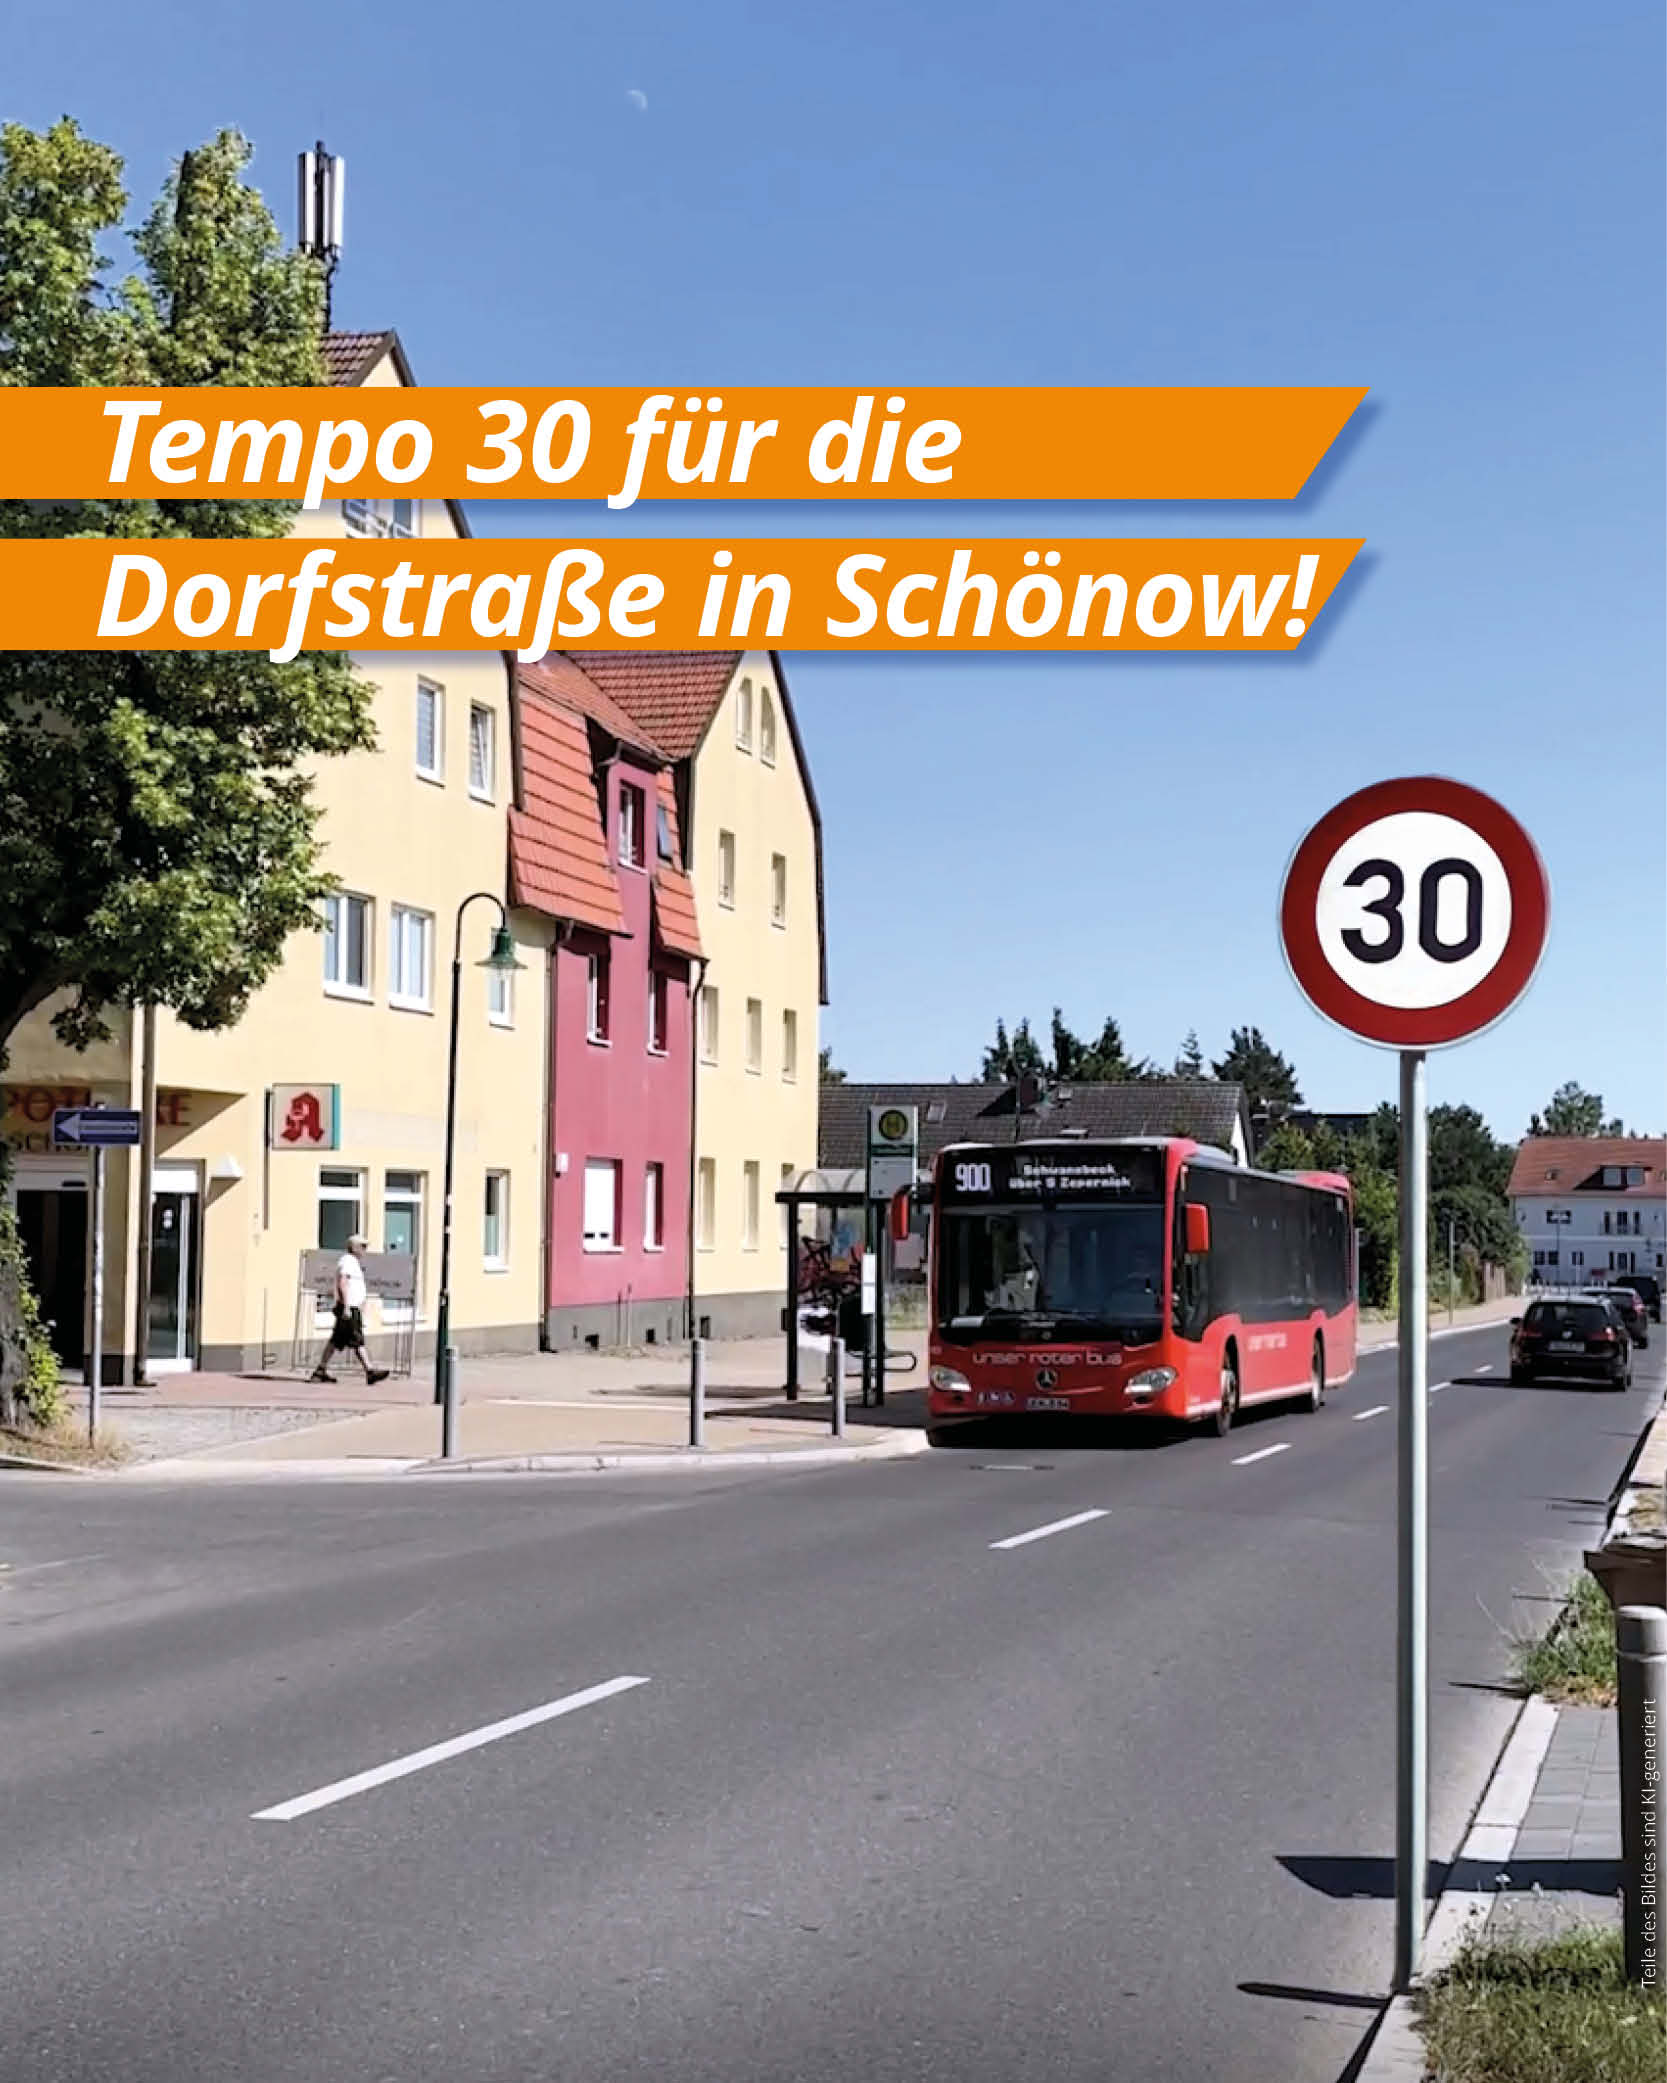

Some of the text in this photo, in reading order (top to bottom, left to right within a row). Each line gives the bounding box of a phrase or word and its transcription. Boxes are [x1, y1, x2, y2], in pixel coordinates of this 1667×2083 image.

[1340, 857, 1483, 964] 30
[955, 1162, 991, 1192] 900
[972, 1350, 1122, 1365] unser roter bus
